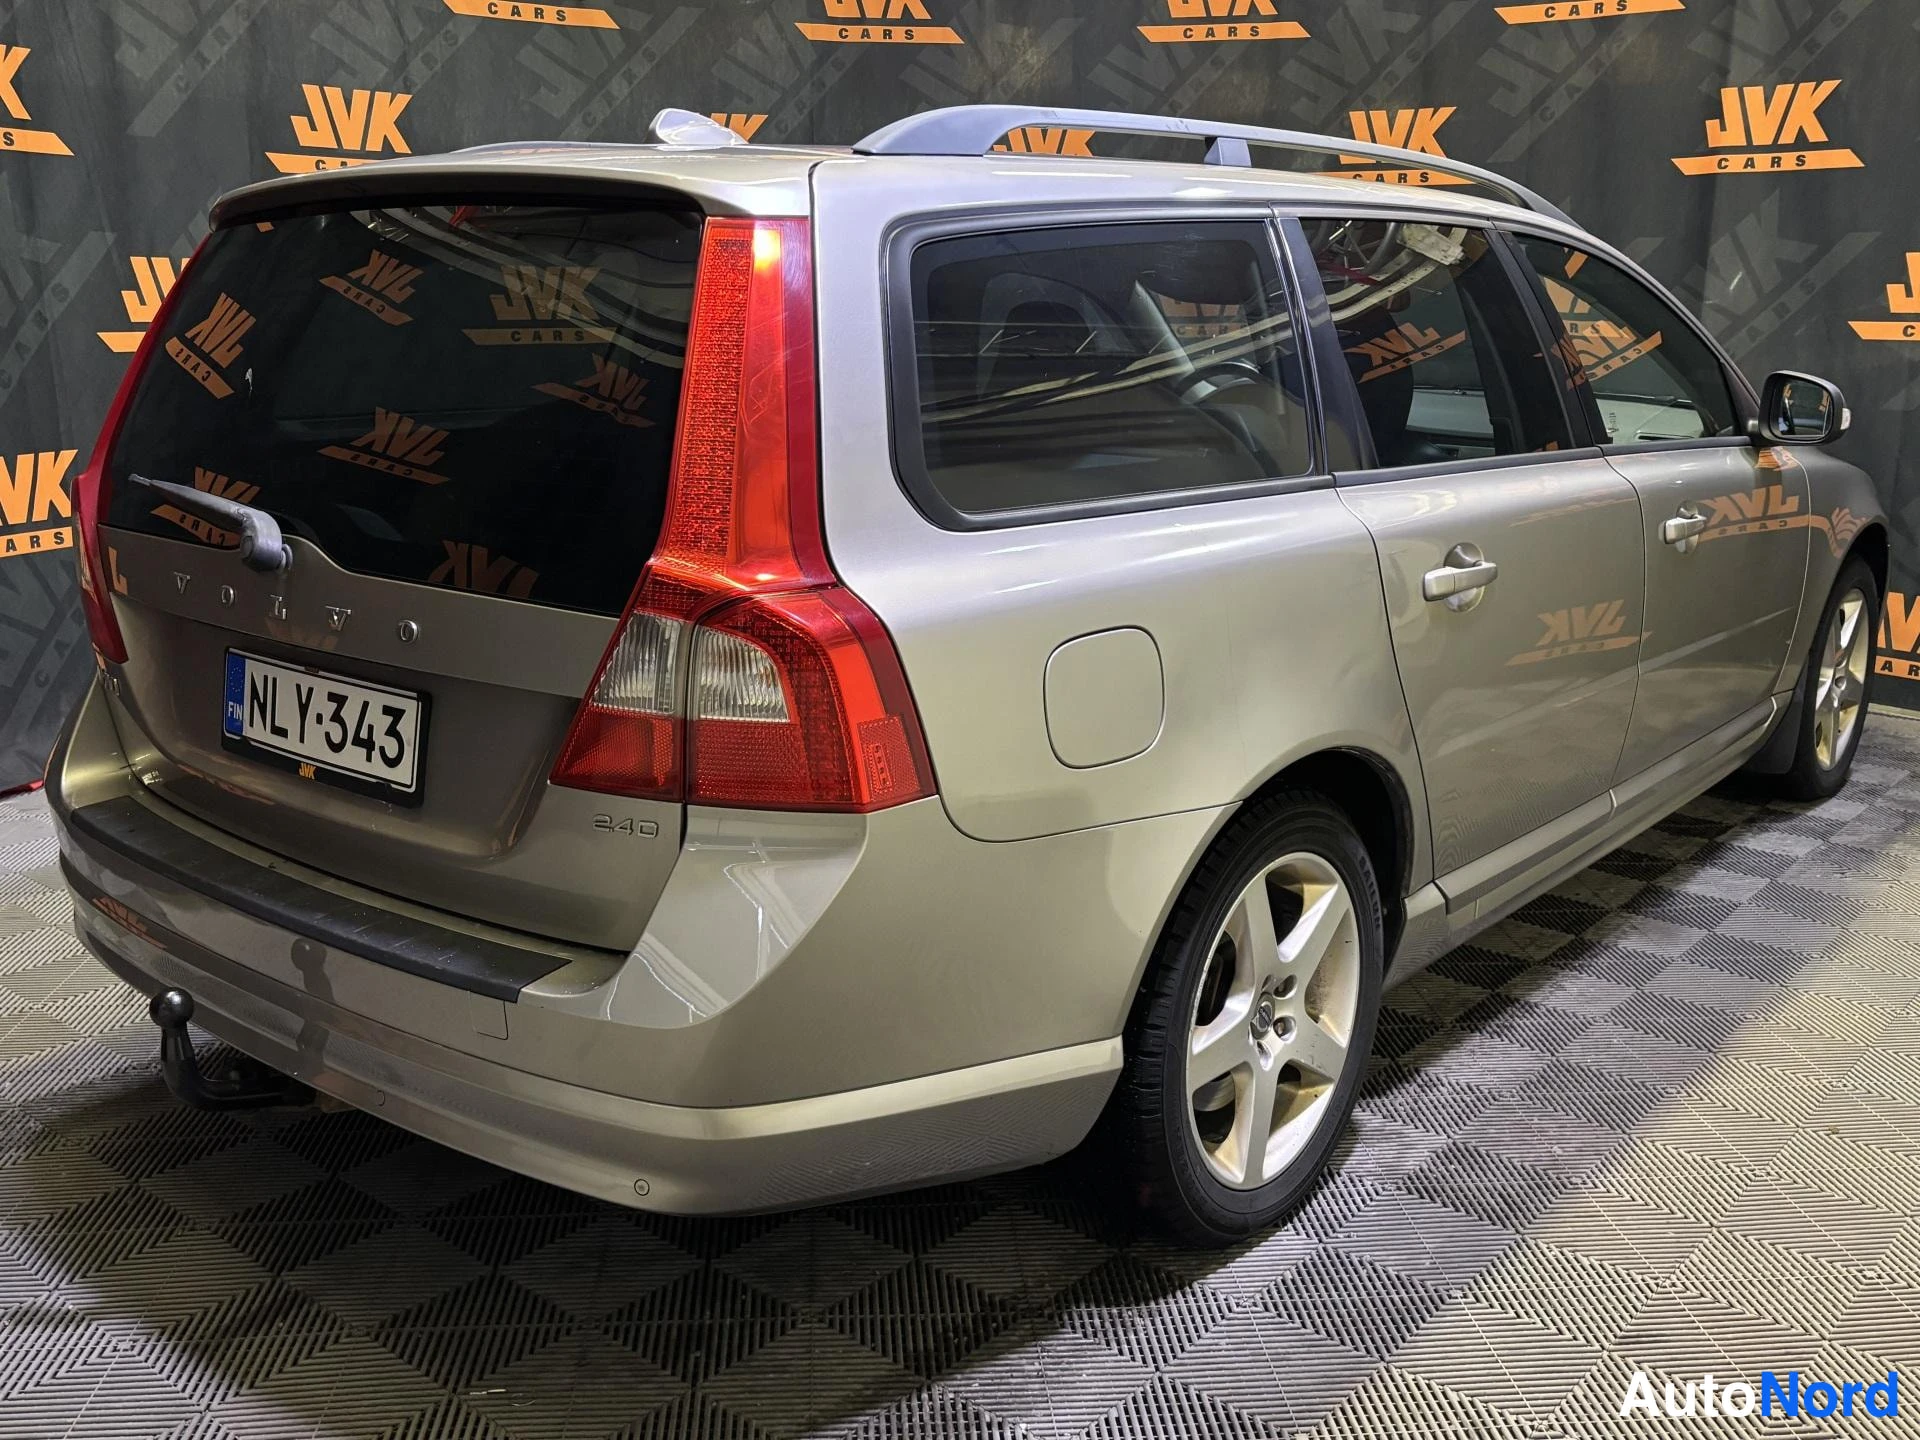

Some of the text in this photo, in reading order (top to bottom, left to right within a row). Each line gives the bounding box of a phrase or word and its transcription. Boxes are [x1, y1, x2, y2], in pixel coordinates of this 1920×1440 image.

[487, 2, 567, 22] CARS
[1544, 0, 1627, 19] CARS
[838, 28, 914, 40] CARS
[1183, 27, 1260, 38] CARS
[290, 83, 413, 154] JVK
[1705, 79, 1842, 148] JVK
[1717, 155, 1806, 170] CARS
[490, 265, 601, 321] JVK
[510, 330, 585, 343] CARS
[0, 449, 78, 527] VK
[6, 531, 65, 553] ARS
[173, 571, 419, 644] VOLVO
[1881, 660, 1920, 677] AR
[228, 701, 243, 721] FIN
[299, 762, 316, 780] JVK
